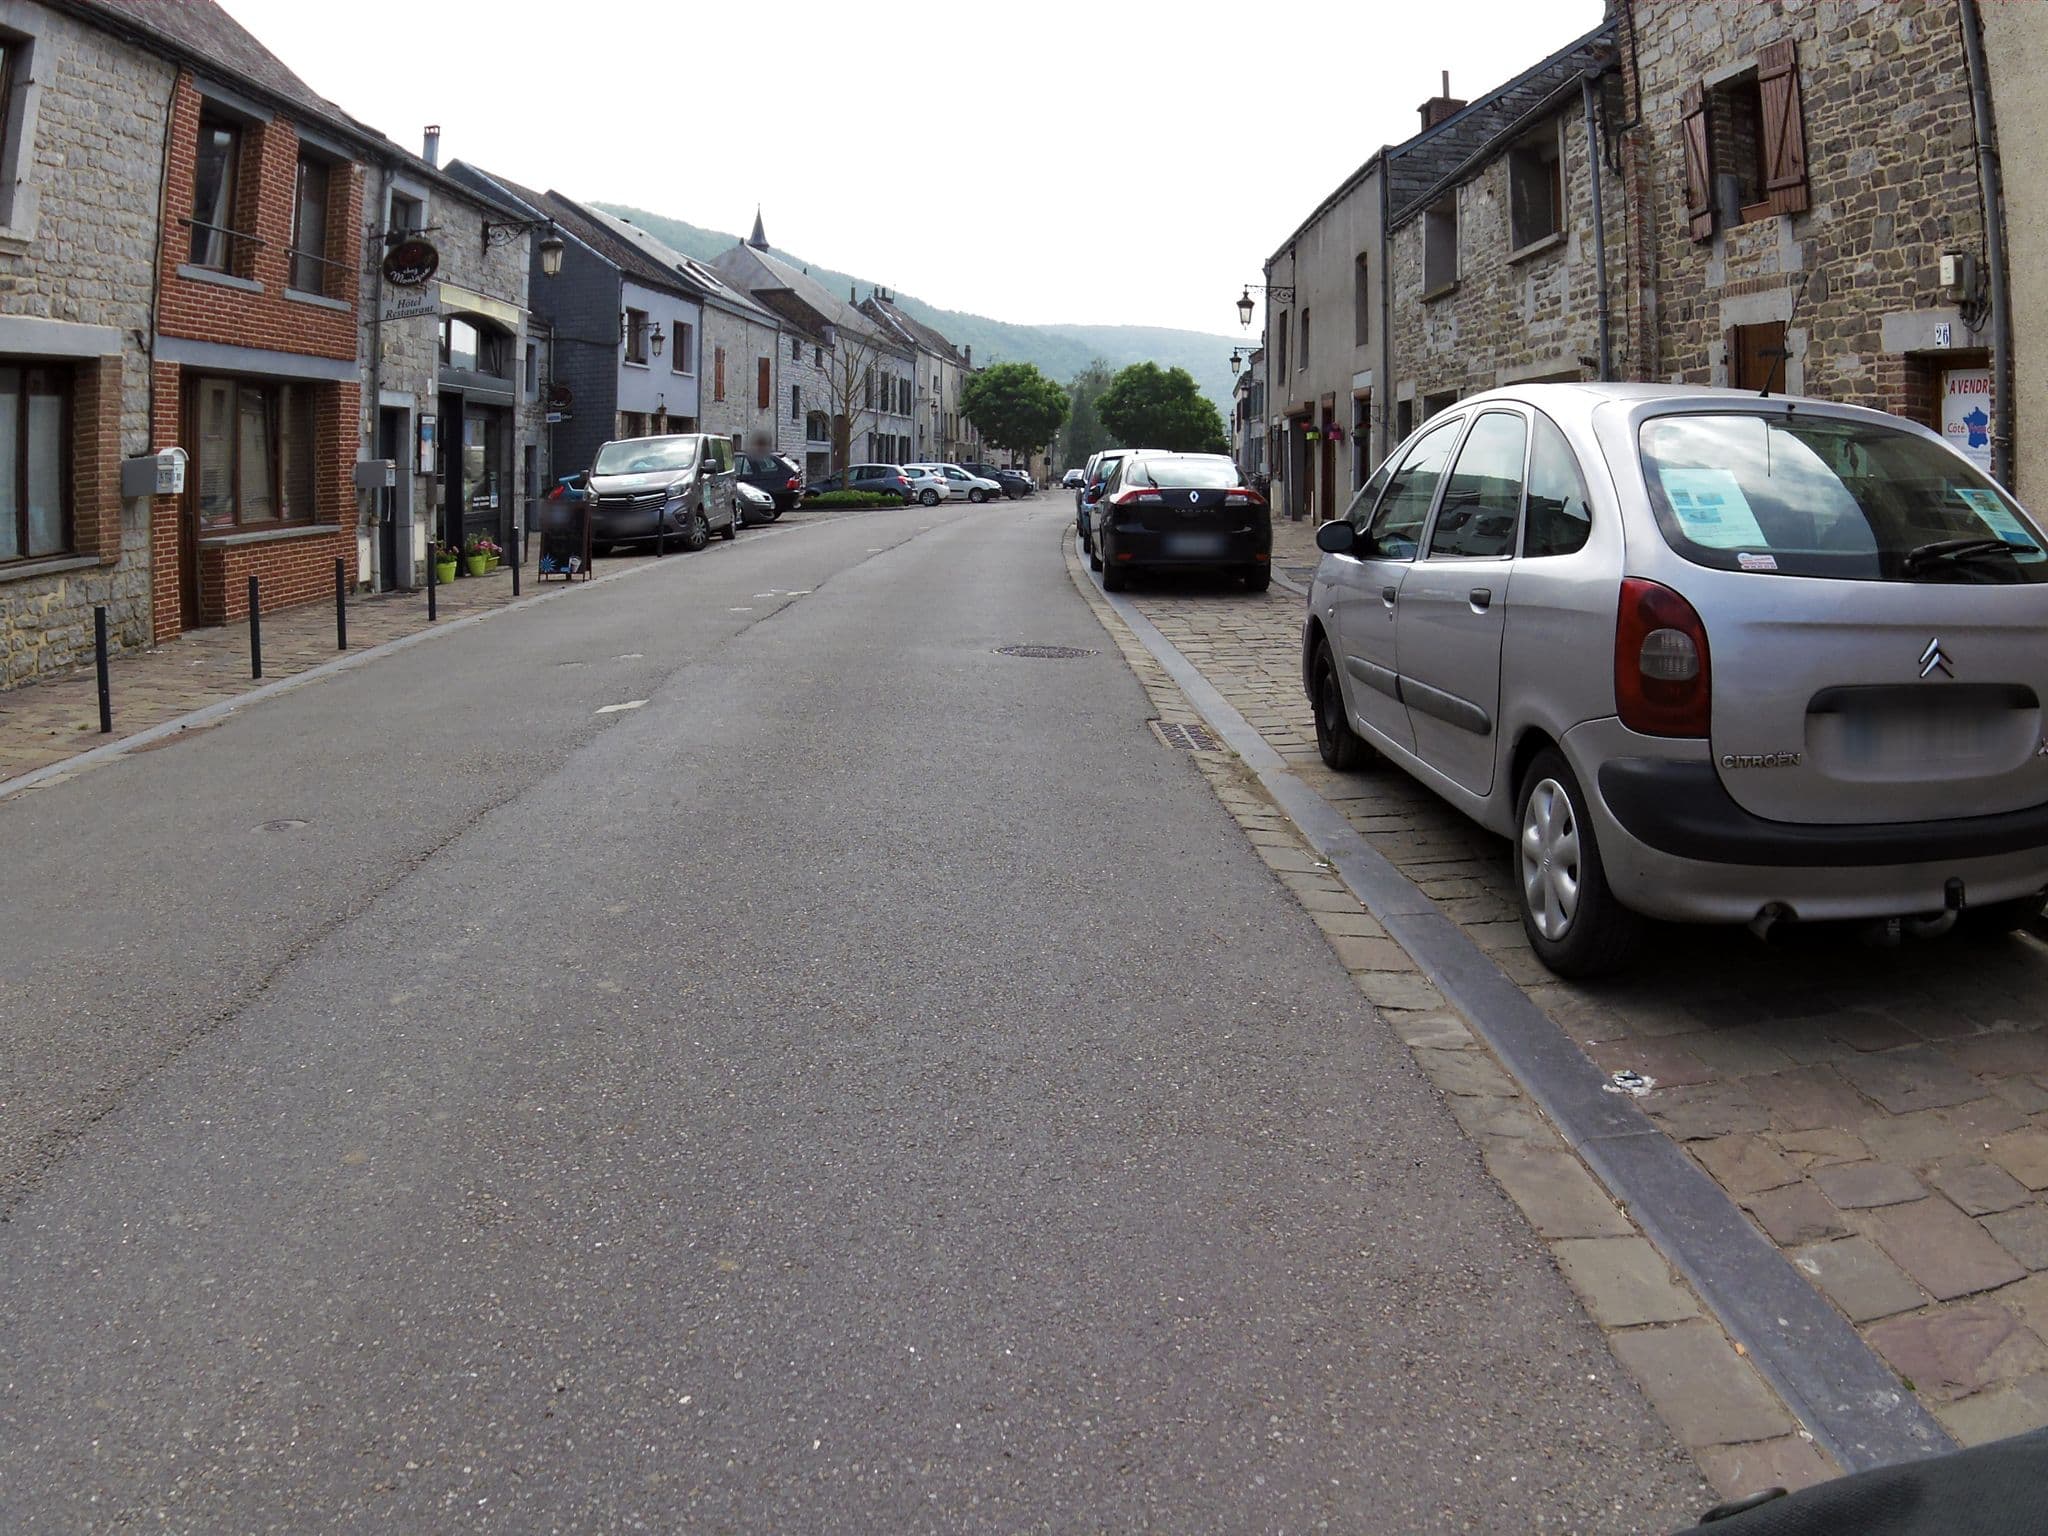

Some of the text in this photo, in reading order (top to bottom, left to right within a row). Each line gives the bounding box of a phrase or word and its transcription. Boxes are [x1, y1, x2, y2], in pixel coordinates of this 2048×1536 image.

[385, 304, 434, 319] Restaurant
[1936, 327, 1949, 345] 26
[1950, 378, 1989, 395] A VENDR
[1947, 422, 1966, 434] Côté
[1721, 751, 1802, 769] CITROËN
